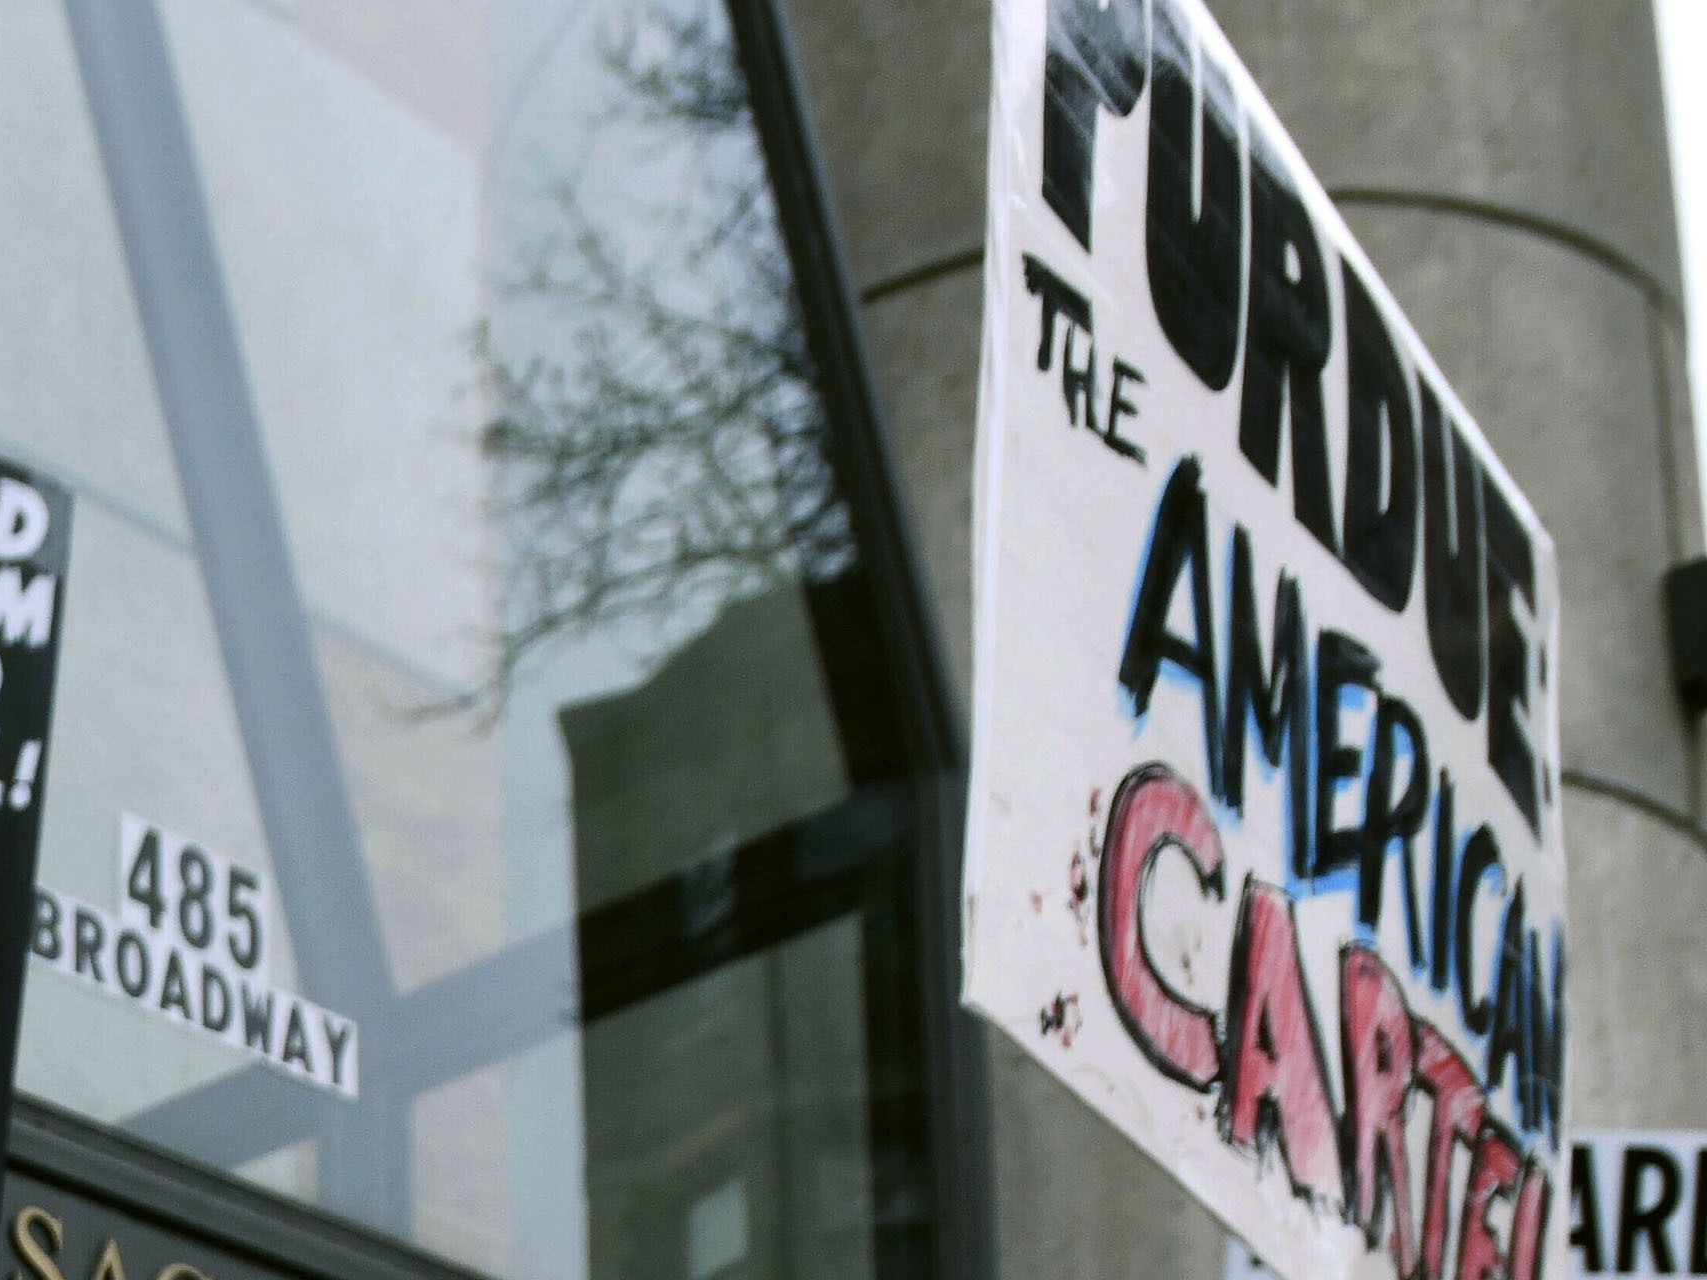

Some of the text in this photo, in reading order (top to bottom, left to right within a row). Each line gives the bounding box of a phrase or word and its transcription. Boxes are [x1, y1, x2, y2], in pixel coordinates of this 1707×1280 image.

[1021, 252, 1149, 468] THE
[124, 826, 265, 970] 485
[1115, 453, 1567, 1152] AMERICAN
[33, 884, 356, 1093] BROADWAY
